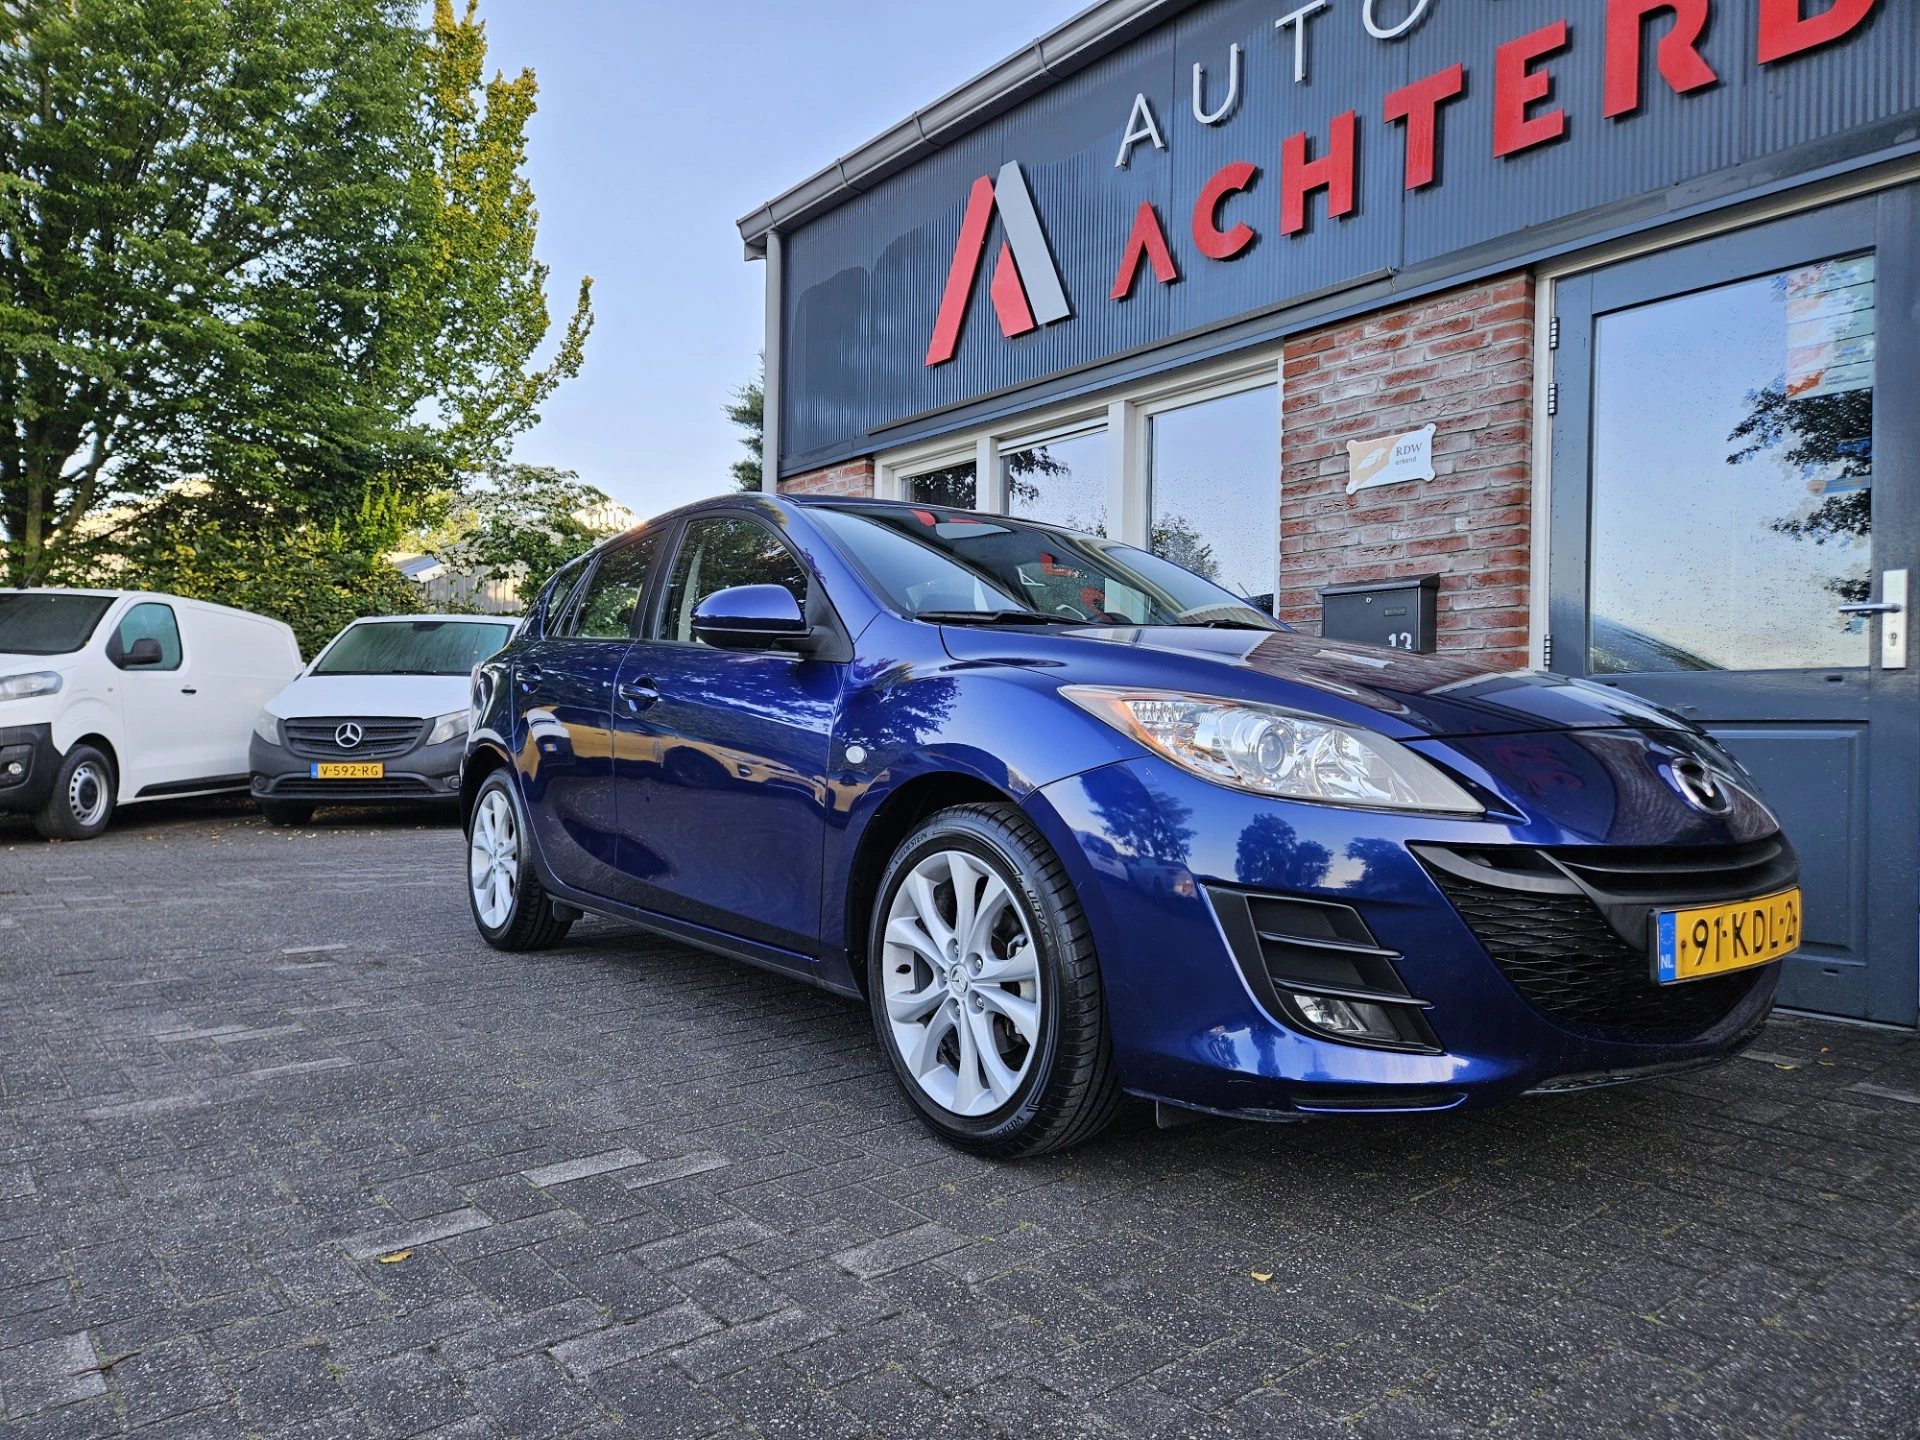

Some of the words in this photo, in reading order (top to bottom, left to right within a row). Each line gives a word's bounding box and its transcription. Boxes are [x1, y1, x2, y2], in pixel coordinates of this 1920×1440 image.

[1395, 442, 1423, 457] RDW
[1395, 455, 1417, 466] erkend
[321, 765, 379, 776] V-592-RG
[1691, 899, 1795, 967] 91-KDL-2
[1660, 953, 1675, 970] NL
